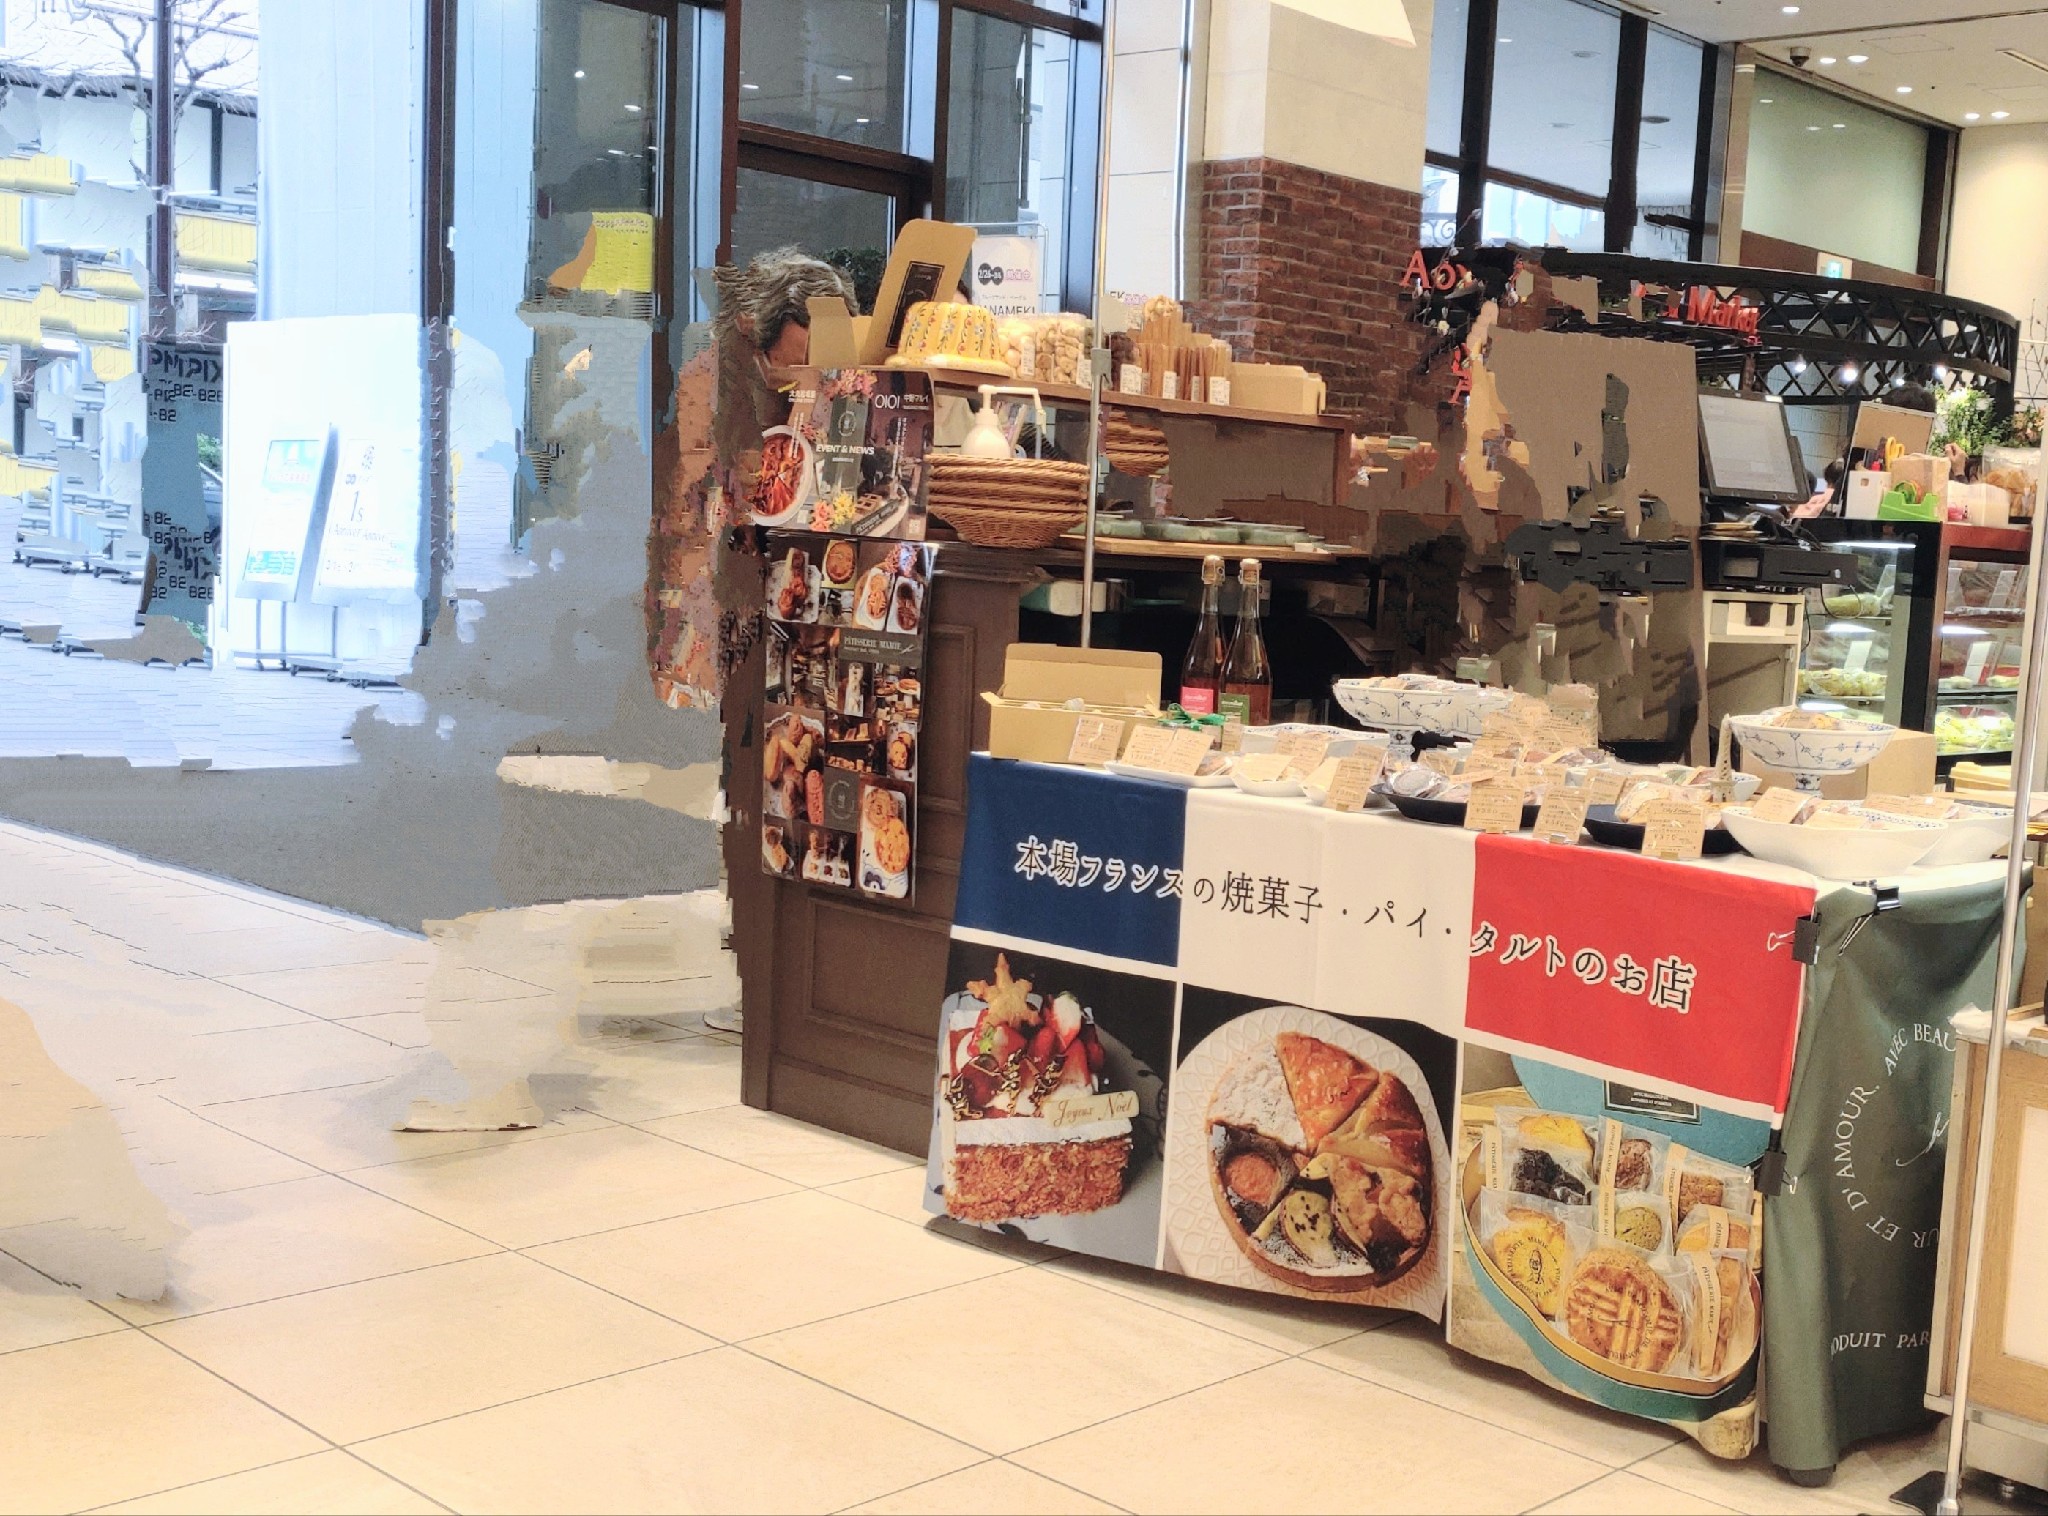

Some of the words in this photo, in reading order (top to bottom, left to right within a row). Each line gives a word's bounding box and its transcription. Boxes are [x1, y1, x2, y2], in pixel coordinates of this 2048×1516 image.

[815, 444, 841, 454] EVENT
[849, 445, 875, 456] NEWS
[1884, 1028, 1908, 1077] AVEC
[1866, 1216, 1903, 1242] ET
[1830, 1332, 1887, 1358] ODUIT
